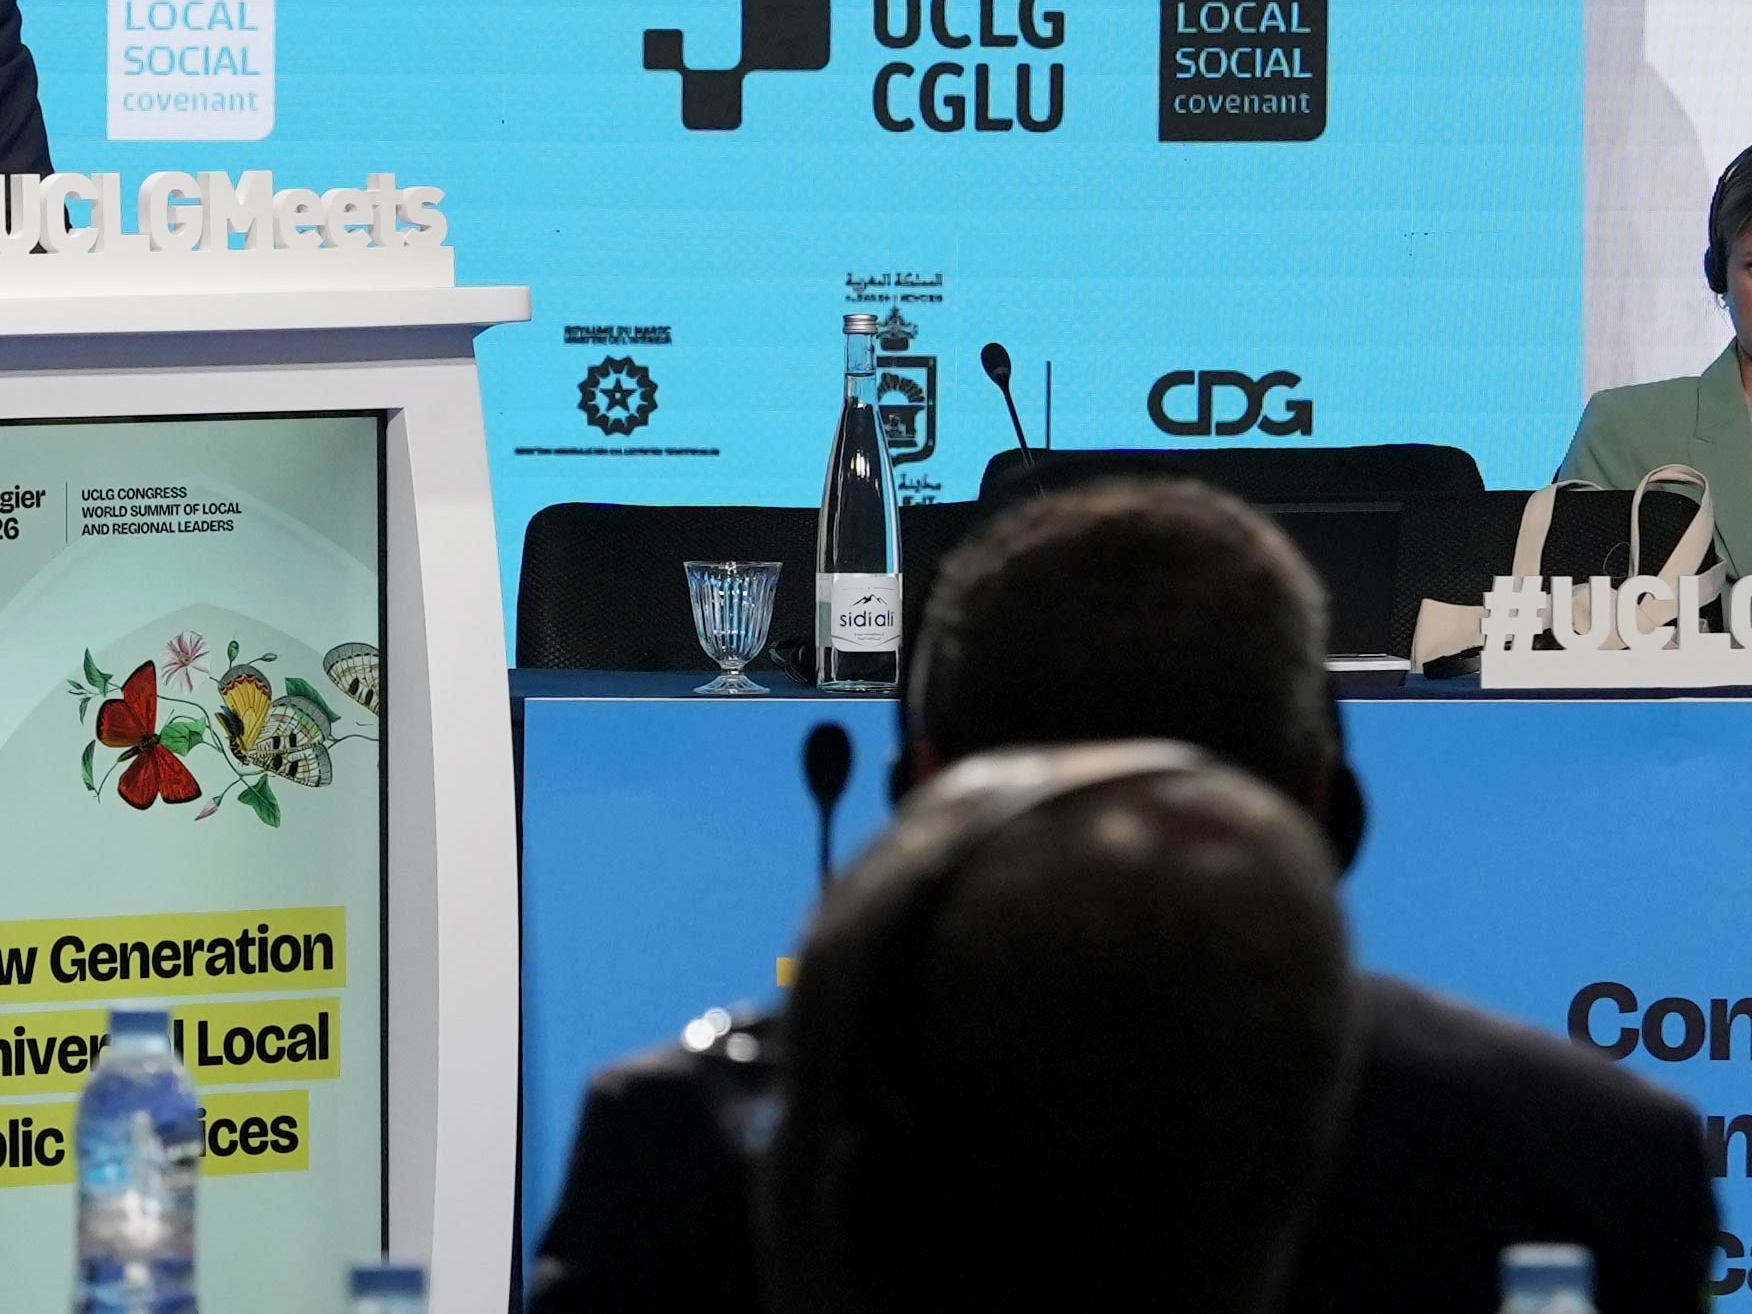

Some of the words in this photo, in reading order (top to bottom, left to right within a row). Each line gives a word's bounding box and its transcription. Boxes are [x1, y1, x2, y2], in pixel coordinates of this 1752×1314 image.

[124, 0, 260, 31] LOCAL
[1175, 1, 1312, 34] LOCAL
[123, 45, 262, 76] SOCIAL
[1175, 47, 1313, 79] SOCIAL
[122, 90, 259, 112] covenant
[871, 61, 1065, 133] CGLU
[1172, 91, 1312, 115] covenant
[1147, 369, 1313, 436] CDG
[81, 488, 115, 502] UCLG
[117, 486, 187, 501] CONGRESS
[81, 505, 128, 519] WORLD
[130, 504, 181, 518] SUMMIT
[183, 503, 200, 517] OF
[202, 502, 243, 516] LOCAL
[81, 523, 110, 537] AND
[112, 521, 176, 535] REGIONAL
[177, 519, 235, 534] LEADERS
[839, 610, 872, 628] sidi
[49, 922, 335, 984] Generation
[196, 1010, 331, 1068] Local
